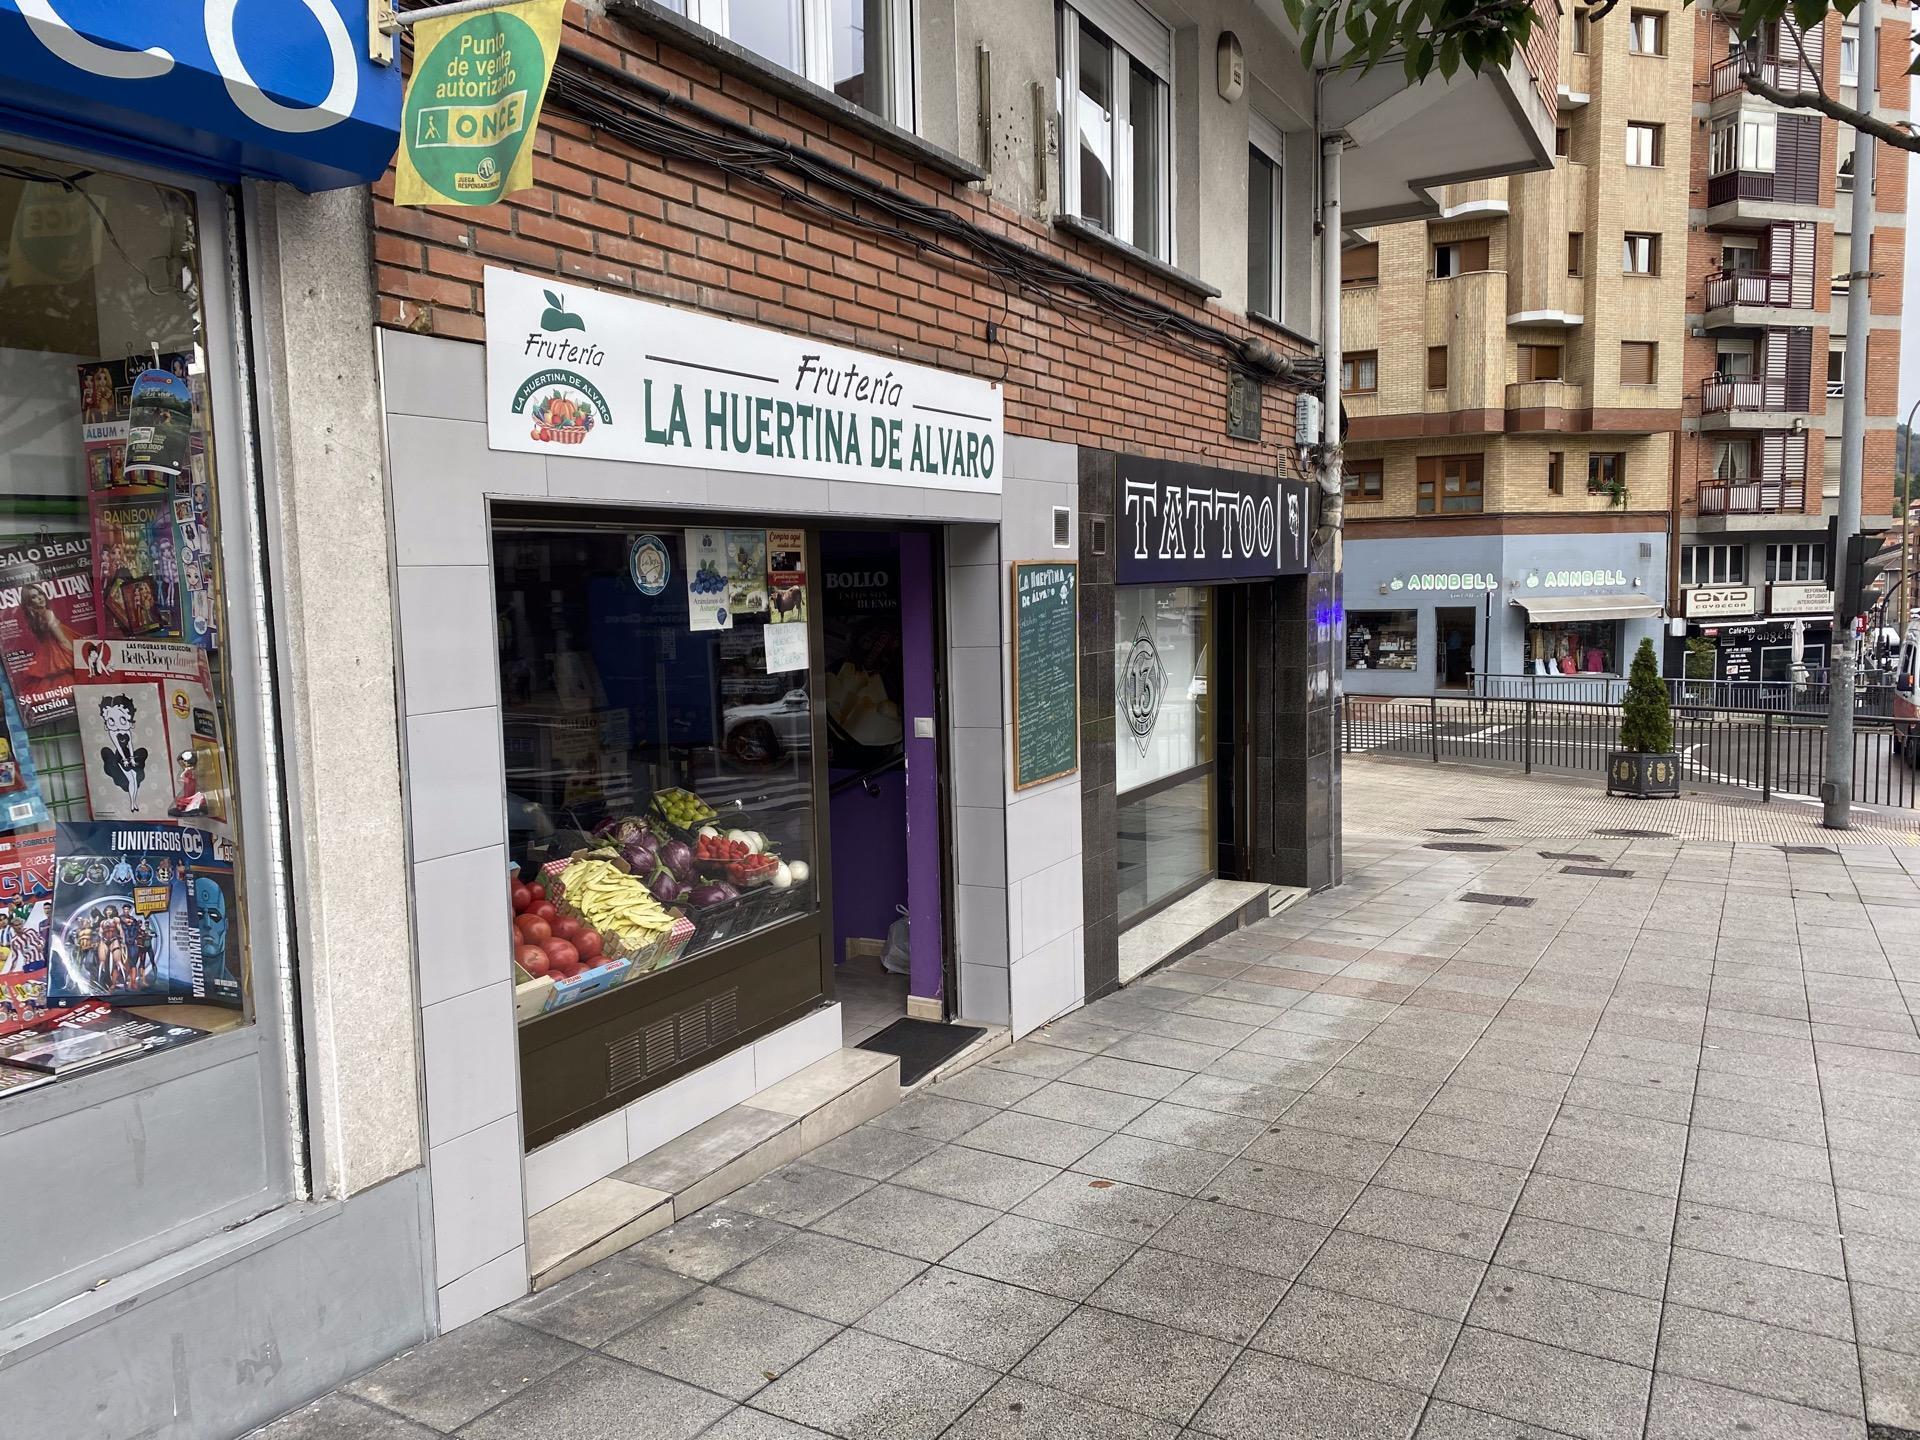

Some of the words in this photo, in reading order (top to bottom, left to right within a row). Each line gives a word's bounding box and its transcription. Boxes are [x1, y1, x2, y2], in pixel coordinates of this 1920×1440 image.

[460, 32, 505, 56] Punto
[447, 57, 469, 77] de
[475, 50, 511, 75] venta
[436, 68, 516, 99] autorizado
[456, 100, 518, 139] ONCE
[524, 333, 605, 367] Frutería
[794, 353, 904, 408] Frutería
[515, 396, 525, 411] LA
[523, 373, 567, 396] HUERTINA
[569, 375, 581, 387] DE
[582, 384, 610, 422] ALVARO
[643, 378, 692, 447] LA
[704, 388, 861, 466] HUERTINA
[870, 418, 902, 472] DE
[909, 422, 995, 480] ALVARO
[1125, 477, 1275, 559] TATTOO
[824, 571, 889, 589] BOLLO
[1407, 573, 1498, 591] ANNBELL
[1544, 569, 1627, 588] ANNBELL
[19, 694, 32, 706] Sé
[33, 691, 45, 701] tu
[45, 685, 73, 699] mejor
[32, 697, 69, 713] versión
[117, 830, 181, 852] UNIVERSOS
[183, 833, 202, 854] DC
[188, 926, 206, 998] WATCHMEN
